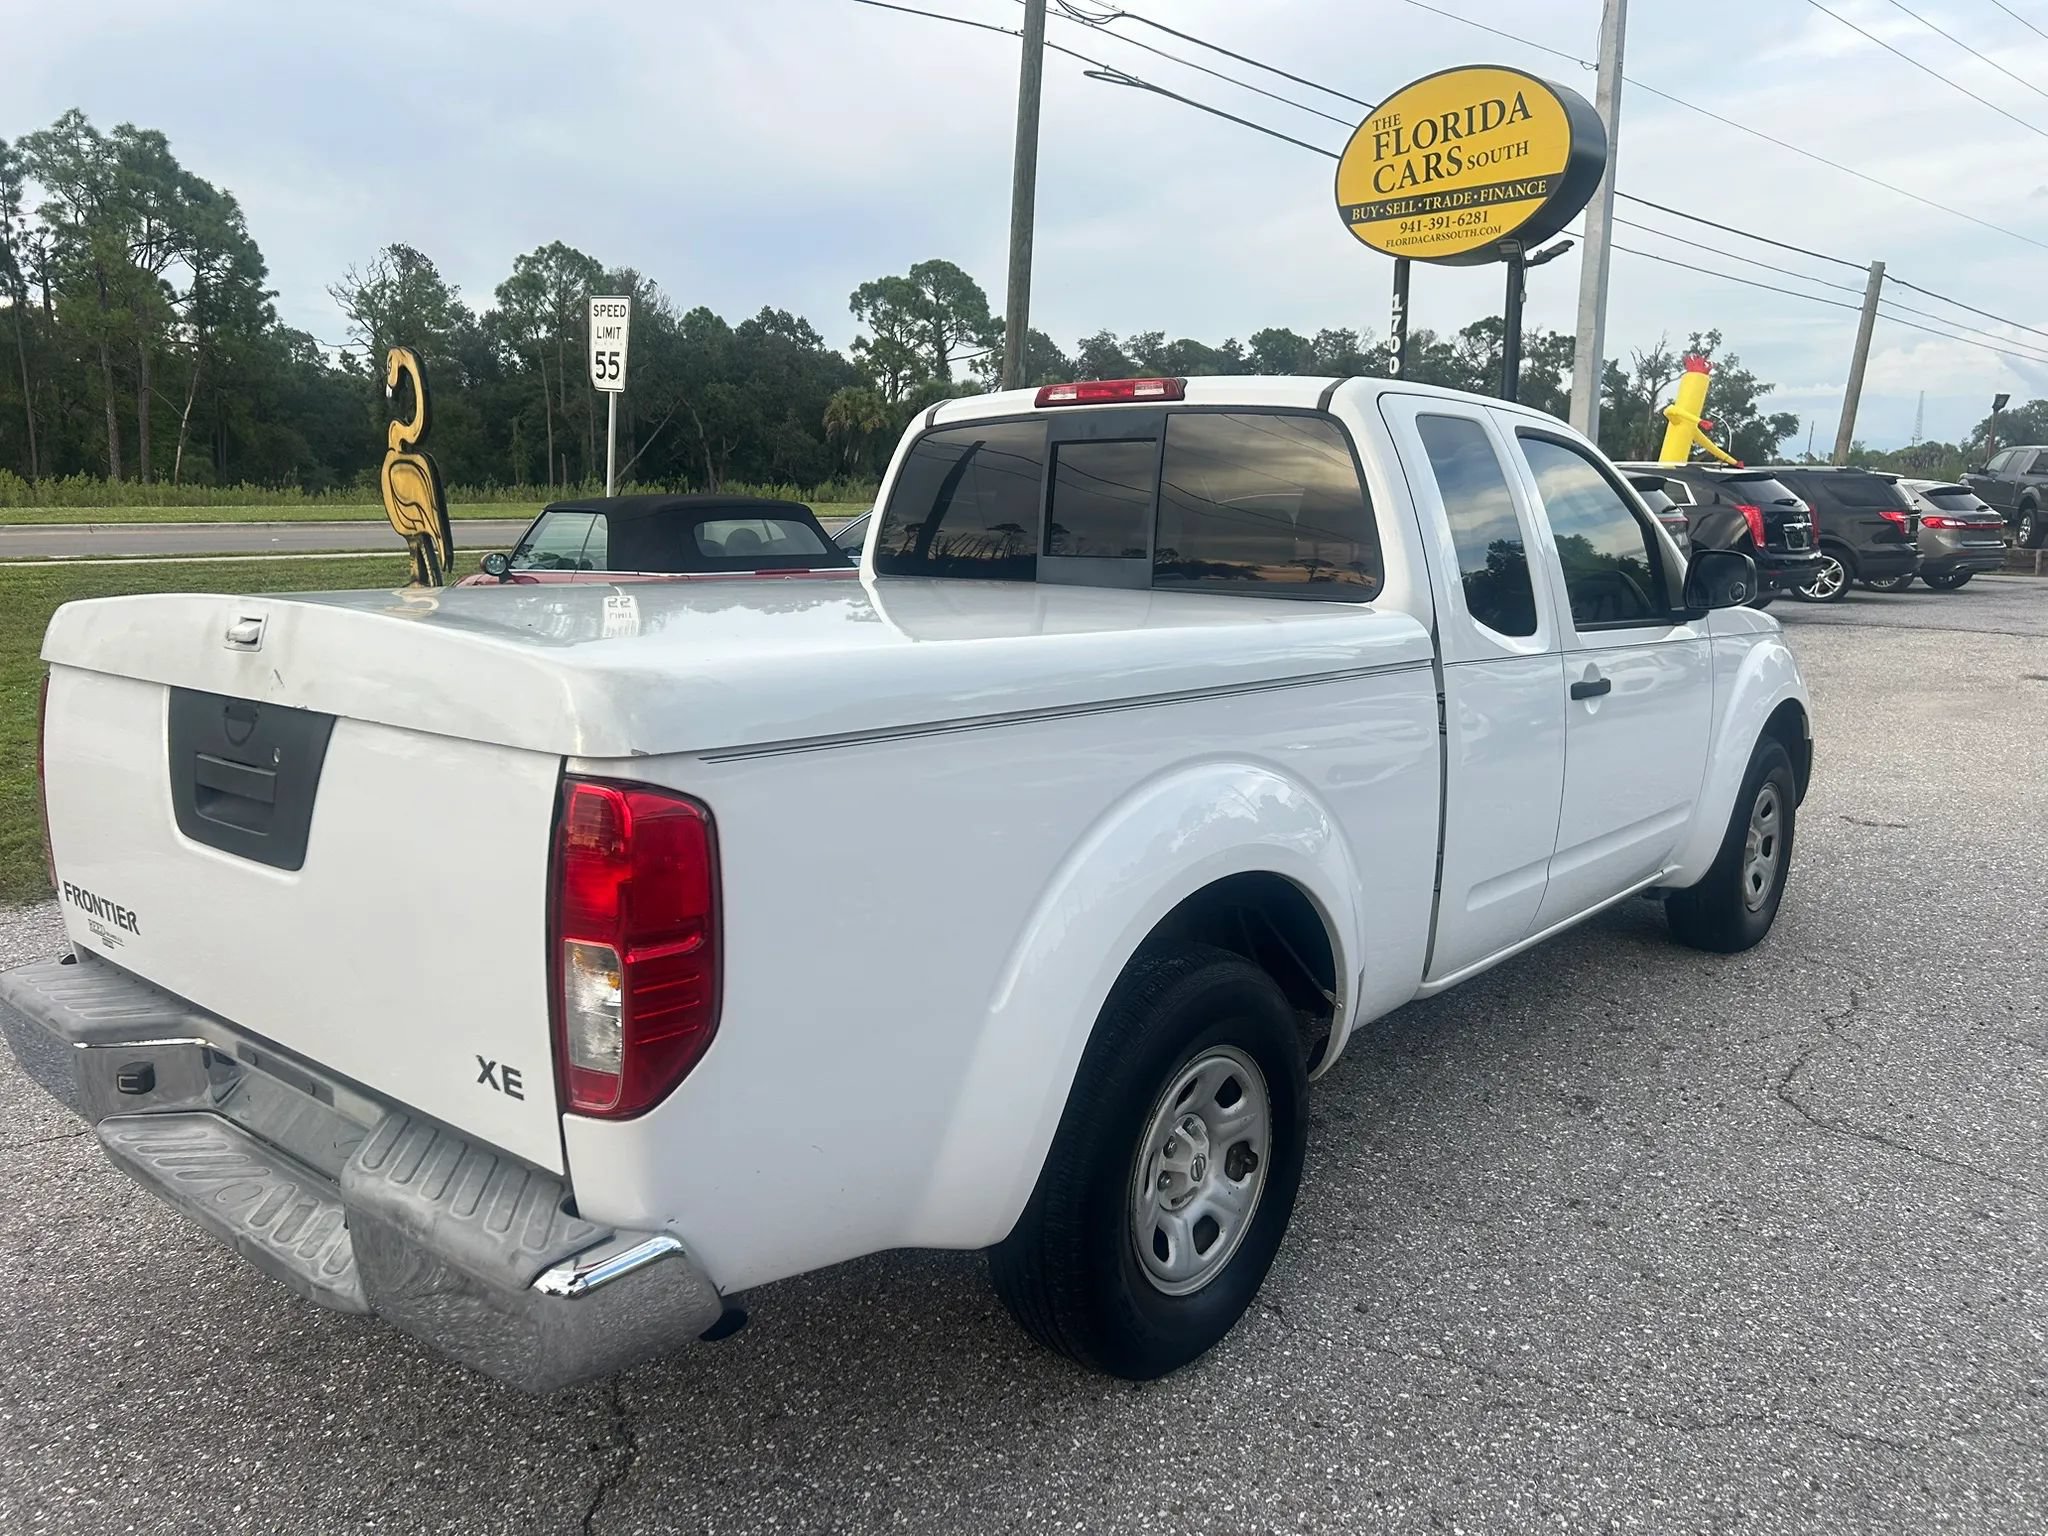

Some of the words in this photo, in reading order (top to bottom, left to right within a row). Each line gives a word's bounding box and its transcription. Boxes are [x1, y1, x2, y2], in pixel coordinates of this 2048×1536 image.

[1372, 113, 1400, 132] THE
[1373, 91, 1532, 162] FLORIDA
[1373, 145, 1463, 194] CARS
[1466, 140, 1529, 170] SOUTH
[1352, 206, 1379, 220] BUY
[1386, 201, 1417, 216] SELL
[1423, 191, 1473, 209] TRADE
[1480, 180, 1546, 202] FINANCE
[1385, 225, 1501, 247] FLORIDACARSSOUTH.COM
[1399, 210, 1489, 235] 941-391-6281
[593, 304, 626, 318] SPEED
[596, 326, 621, 340] LIMIT
[595, 351, 620, 380] 55
[63, 880, 140, 936] FRONTIER
[476, 1054, 525, 1101] XE
